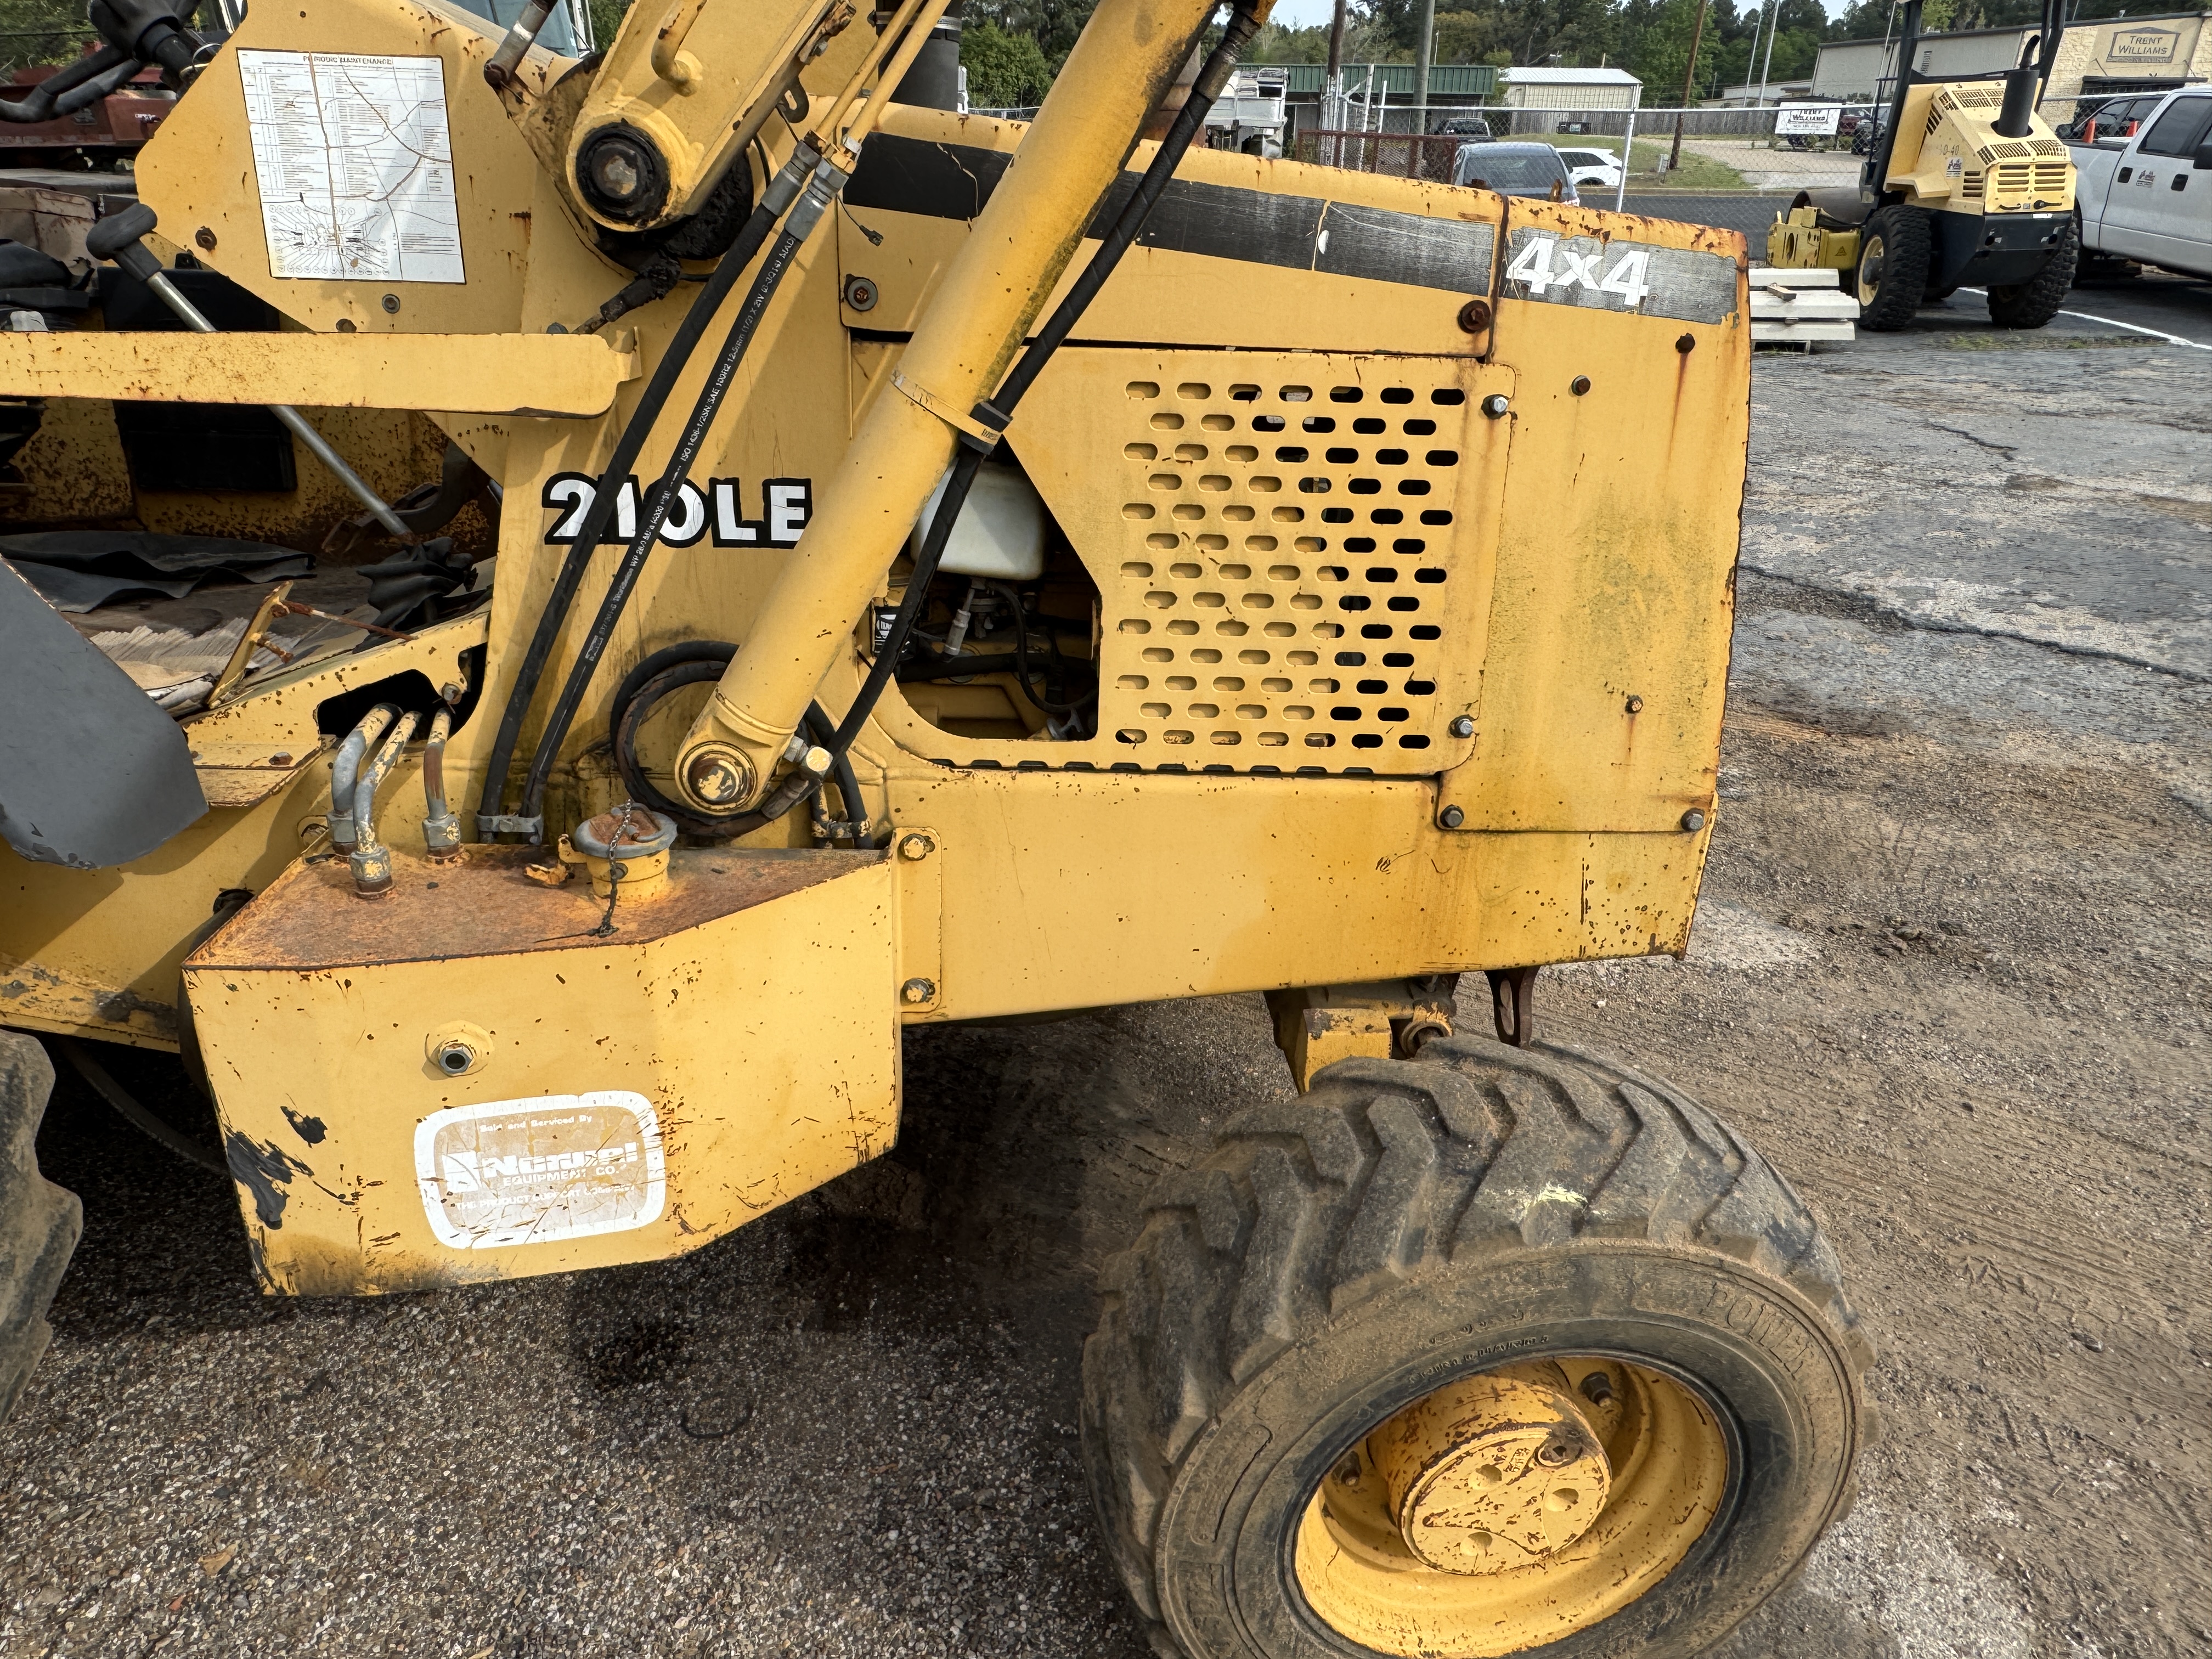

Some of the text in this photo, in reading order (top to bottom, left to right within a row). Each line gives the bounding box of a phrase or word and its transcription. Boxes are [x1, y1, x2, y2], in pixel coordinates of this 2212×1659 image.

[2130, 35, 2163, 44] TRENT
[2118, 45, 2168, 55] WILLIAMS
[680, 447, 691, 461] ISO
[543, 473, 811, 546] 210LE
[503, 1168, 587, 1187] EQUIPMENT
